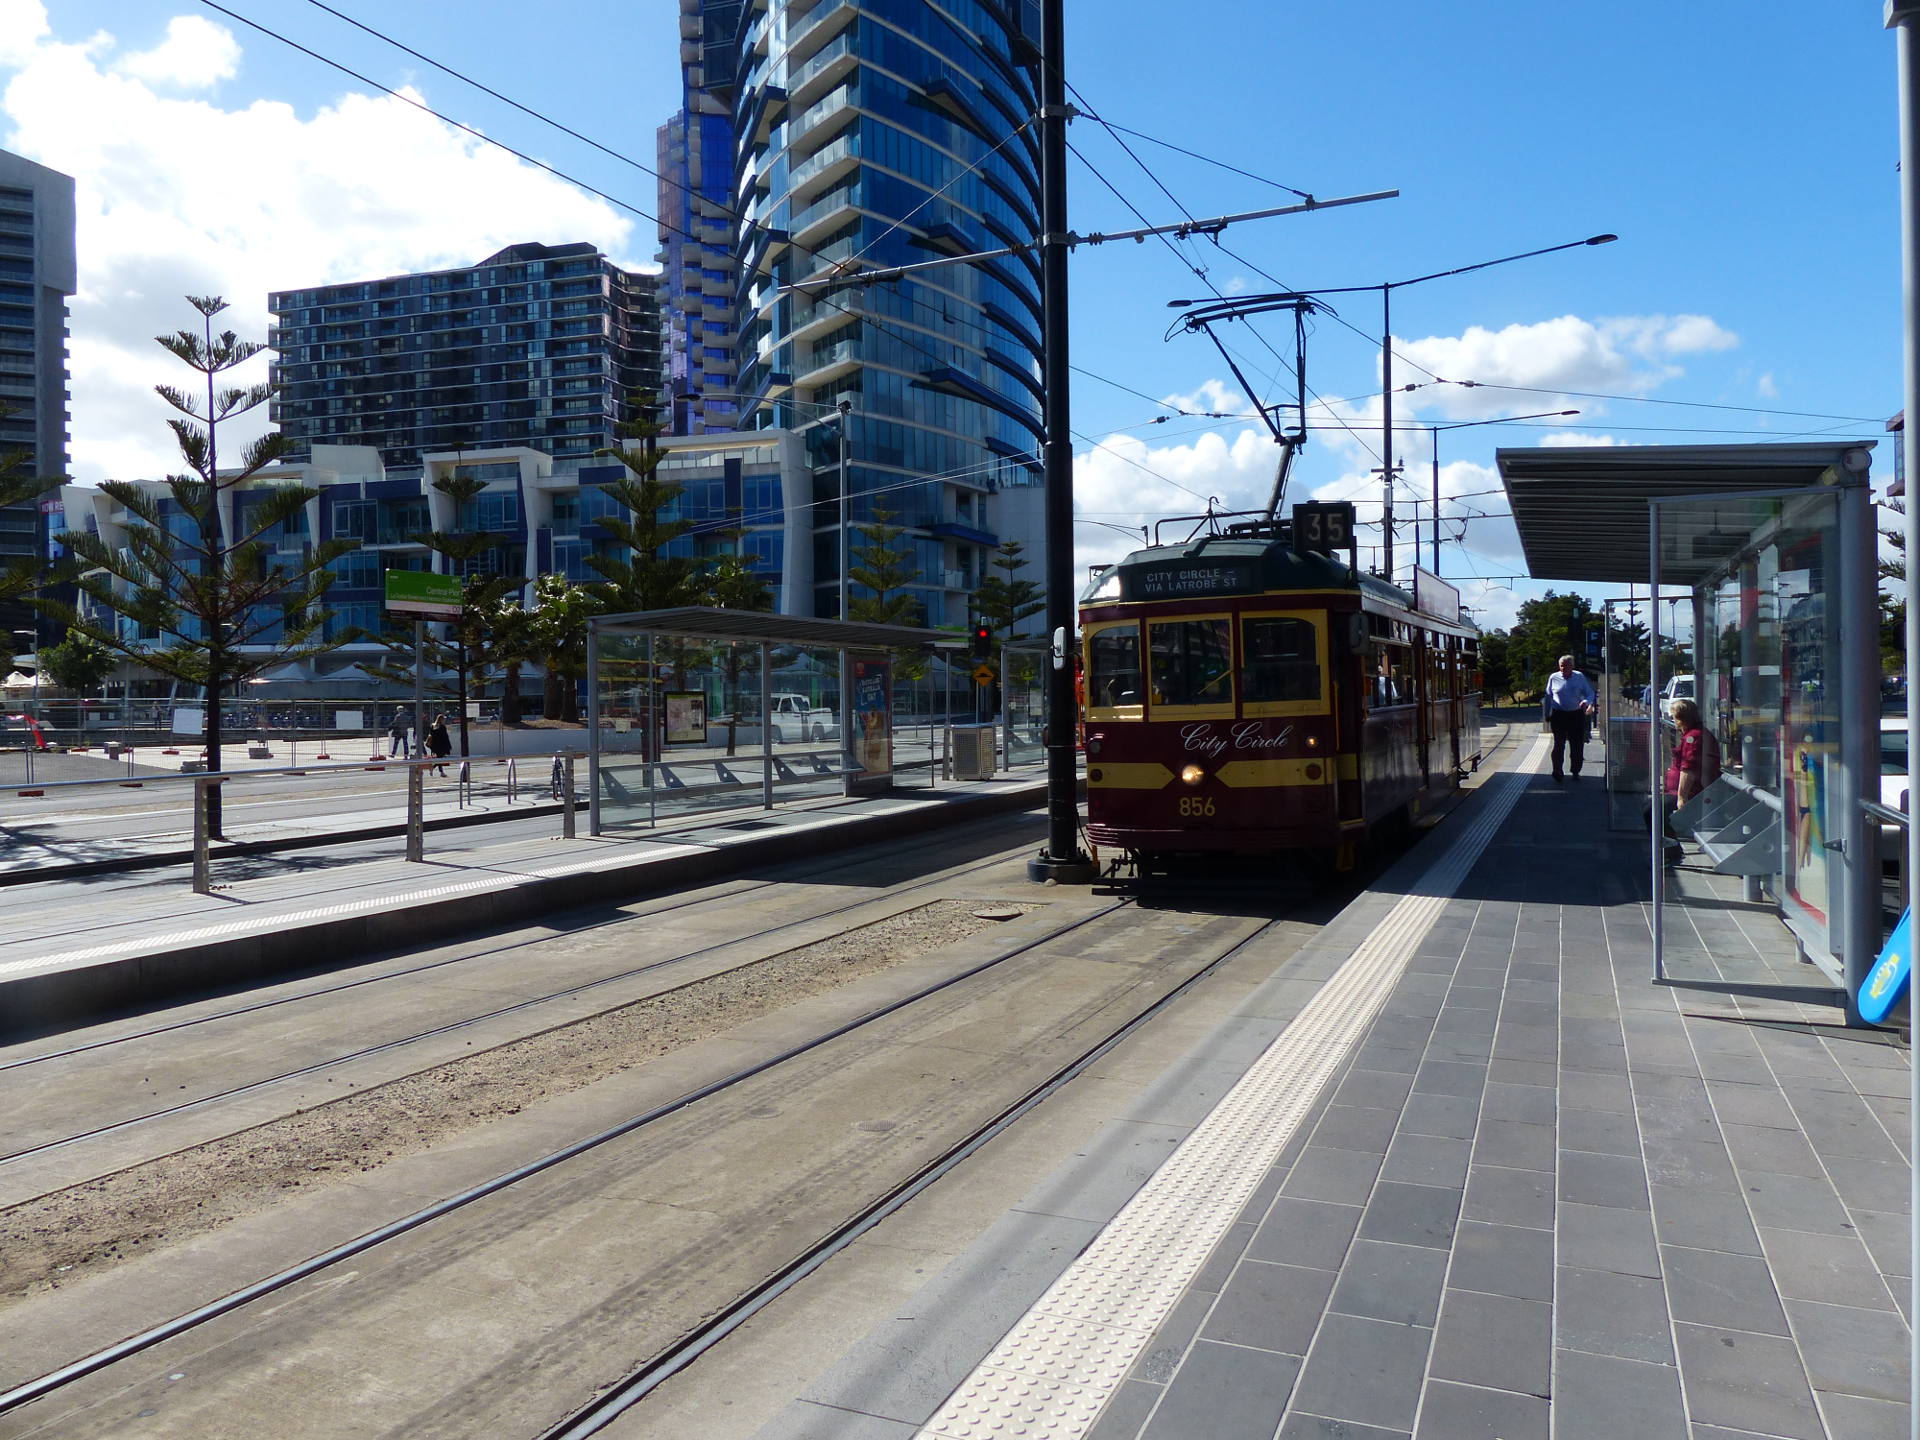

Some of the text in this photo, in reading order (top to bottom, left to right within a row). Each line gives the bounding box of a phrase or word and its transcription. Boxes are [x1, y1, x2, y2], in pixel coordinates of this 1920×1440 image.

[1307, 512, 1344, 542] 35
[1145, 577, 1237, 593] VIA LATROBE ST
[1146, 568, 1220, 583] CITY CIRCLE
[1180, 721, 1294, 759] City Circle
[1179, 796, 1216, 817] 856
